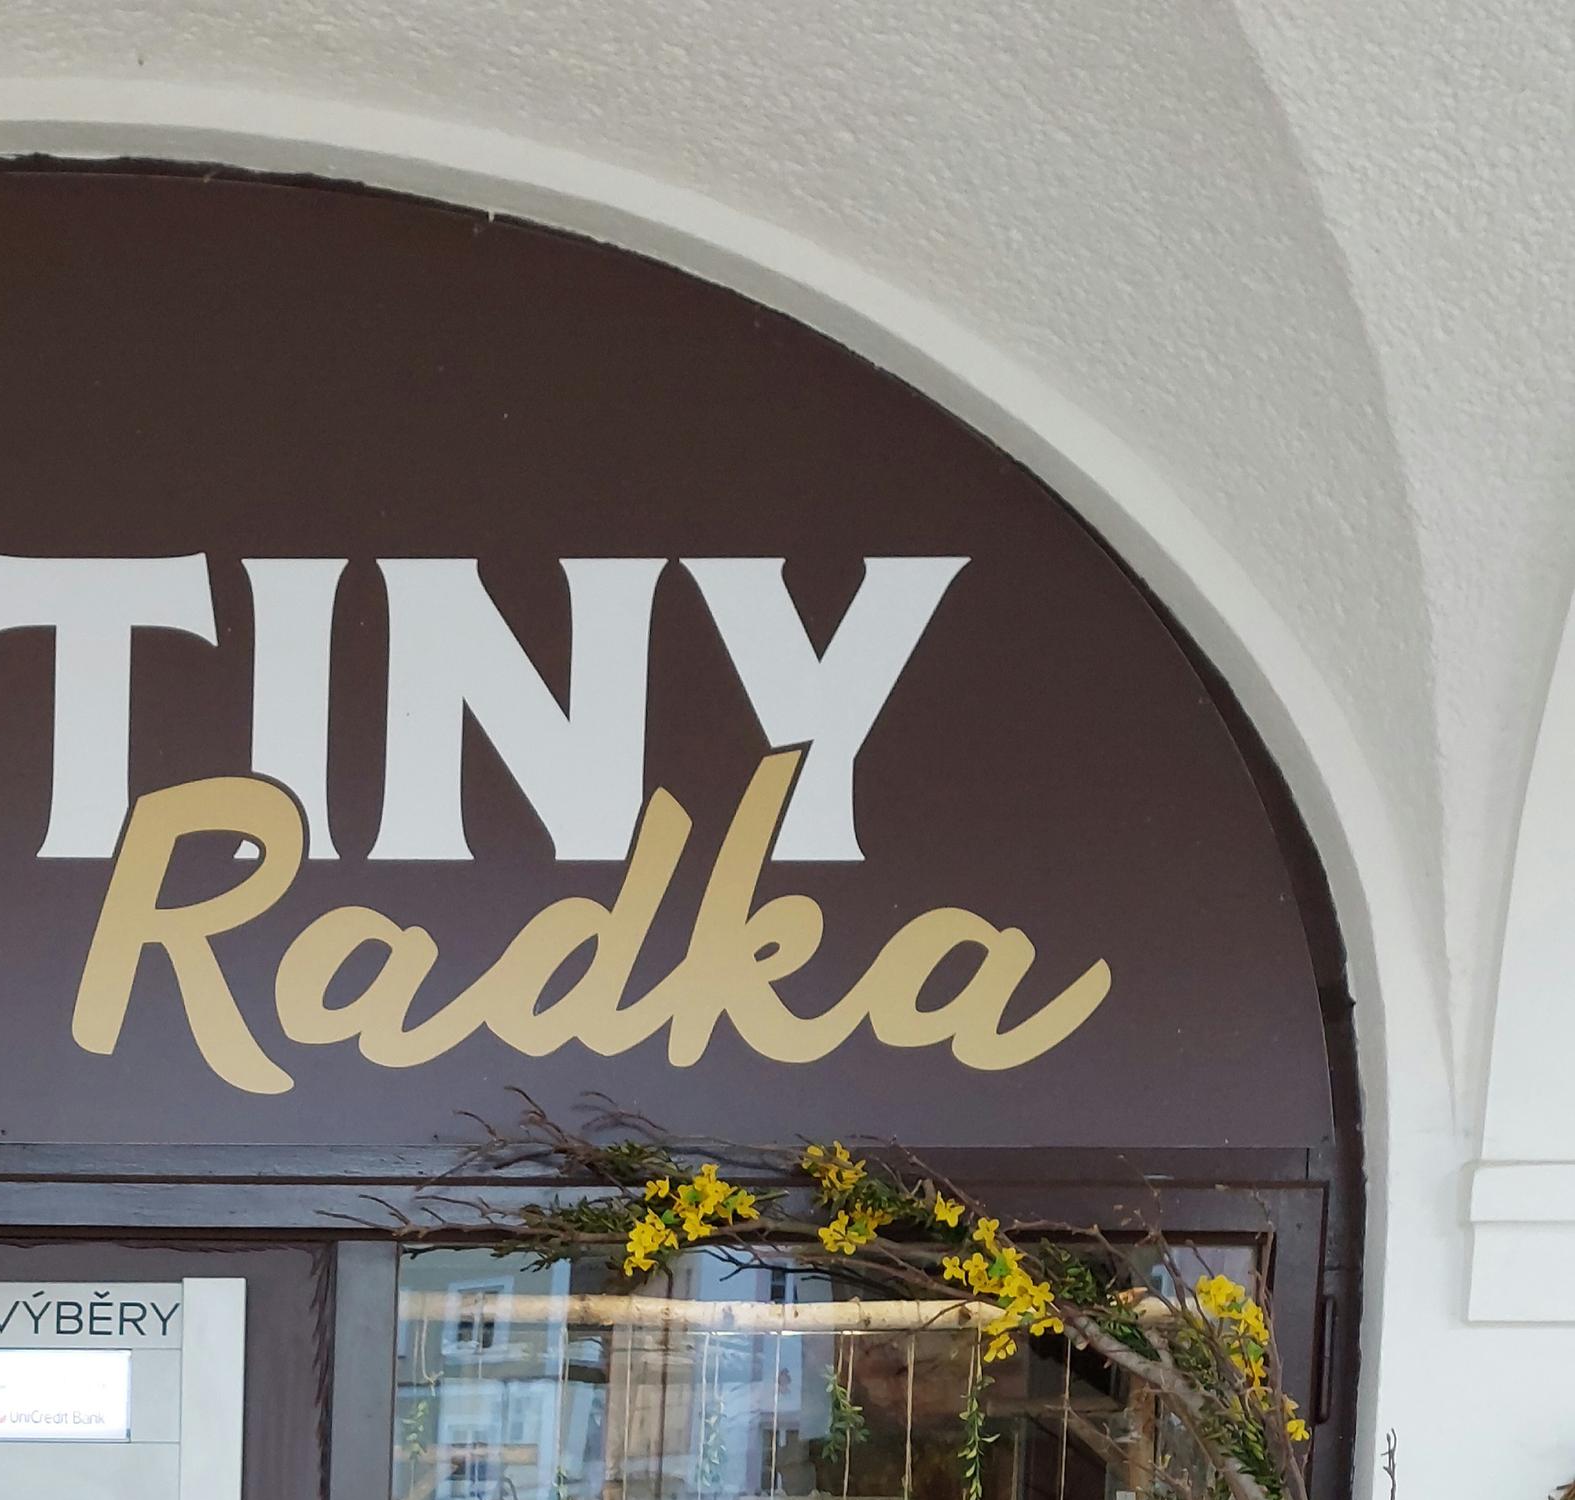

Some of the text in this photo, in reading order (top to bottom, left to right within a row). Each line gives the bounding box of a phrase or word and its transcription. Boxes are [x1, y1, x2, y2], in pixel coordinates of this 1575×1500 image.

[72, 752, 1109, 1094] Radka
[9, 1410, 105, 1425] UniCredit Bank
